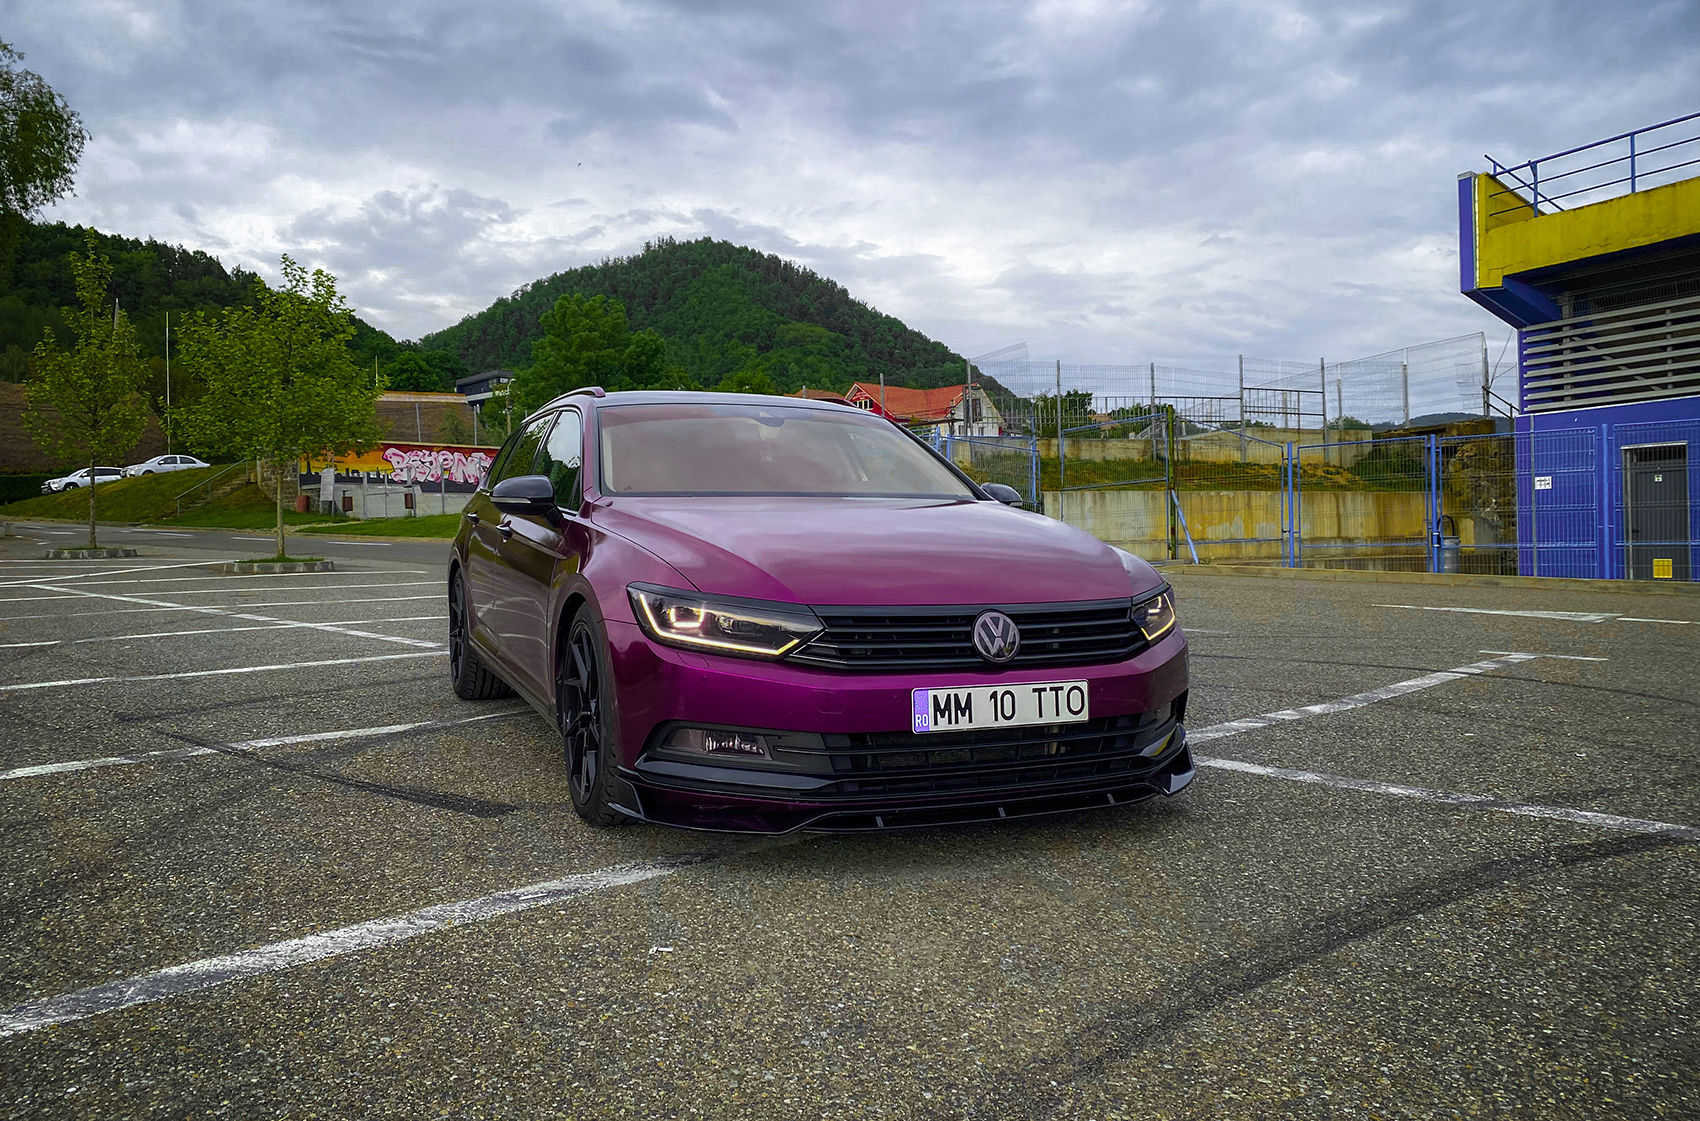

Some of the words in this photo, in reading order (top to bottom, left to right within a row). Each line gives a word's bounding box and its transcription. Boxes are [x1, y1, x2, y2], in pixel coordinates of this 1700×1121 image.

[973, 611, 1020, 661] VW
[915, 713, 929, 727] RO
[932, 692, 974, 726] MM
[989, 690, 1017, 722] 10
[1031, 685, 1085, 718] TTO
